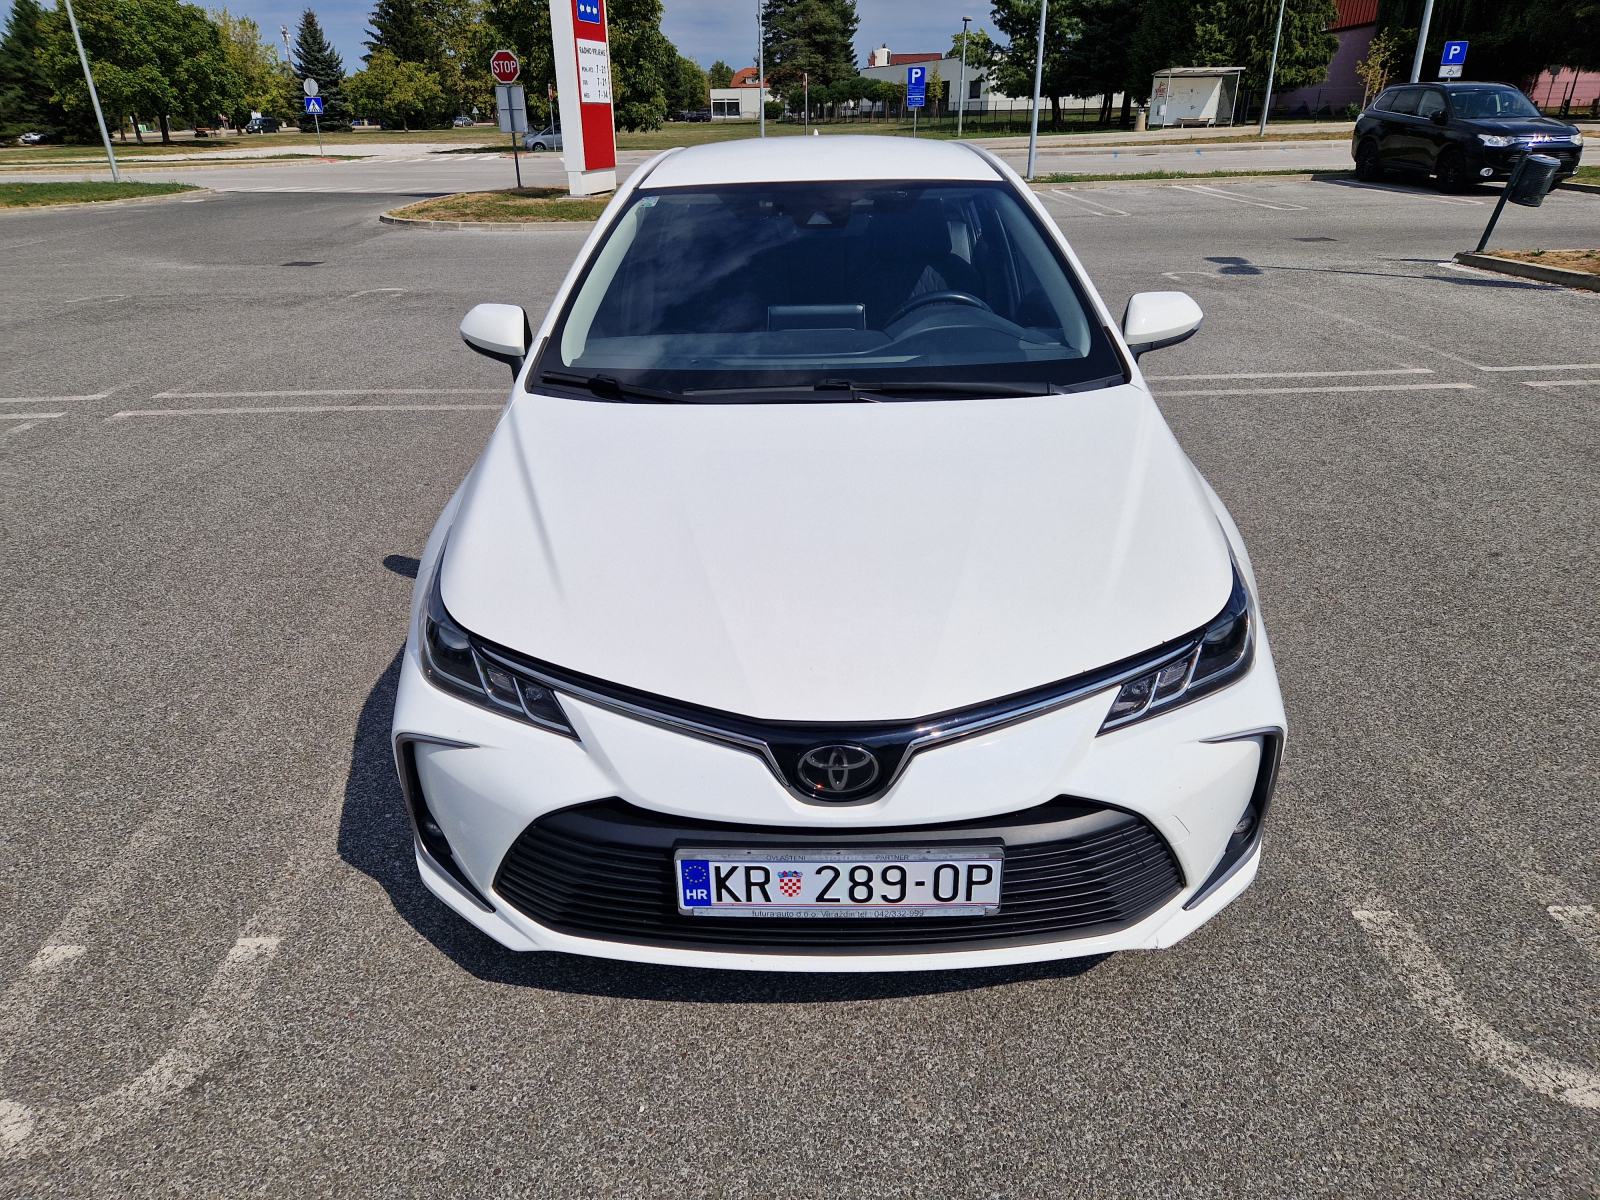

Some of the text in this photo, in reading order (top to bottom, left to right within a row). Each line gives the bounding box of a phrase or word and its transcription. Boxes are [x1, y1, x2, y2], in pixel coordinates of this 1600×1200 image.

[1448, 45, 1461, 60] P
[493, 60, 517, 73] STOP
[911, 68, 922, 84] P
[714, 864, 993, 903] KR 289-OP
[685, 888, 708, 900] HR
